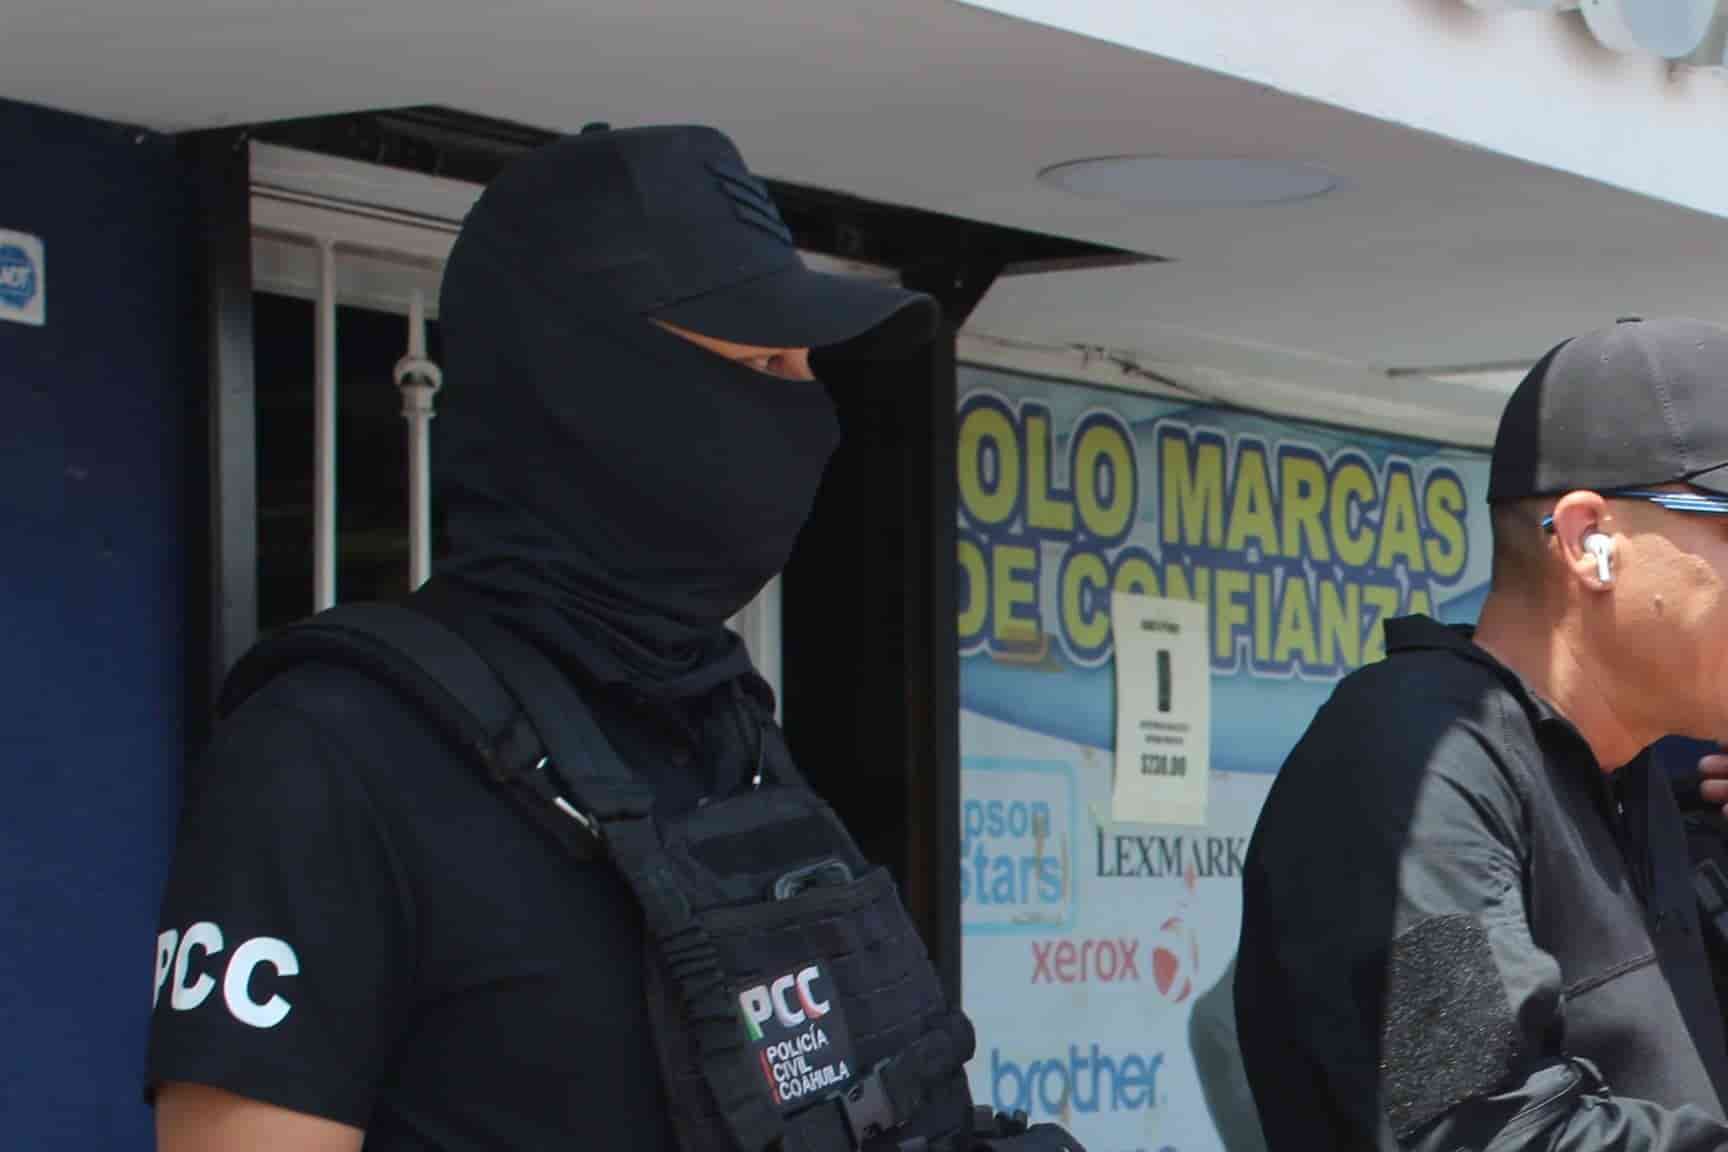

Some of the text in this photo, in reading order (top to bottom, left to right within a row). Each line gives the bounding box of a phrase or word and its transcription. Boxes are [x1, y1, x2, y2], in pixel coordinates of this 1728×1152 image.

[1162, 434, 1468, 577] MARCAS
[1096, 825, 1246, 878] LEXMARK
[153, 921, 299, 1028] PCC
[1030, 937, 1140, 984] xerox
[739, 965, 831, 1041] PCC
[766, 1022, 829, 1065] POLICÍA
[772, 1055, 813, 1083] CIVIL
[779, 1059, 850, 1101] COAHUILA
[990, 1042, 1165, 1118] brother
